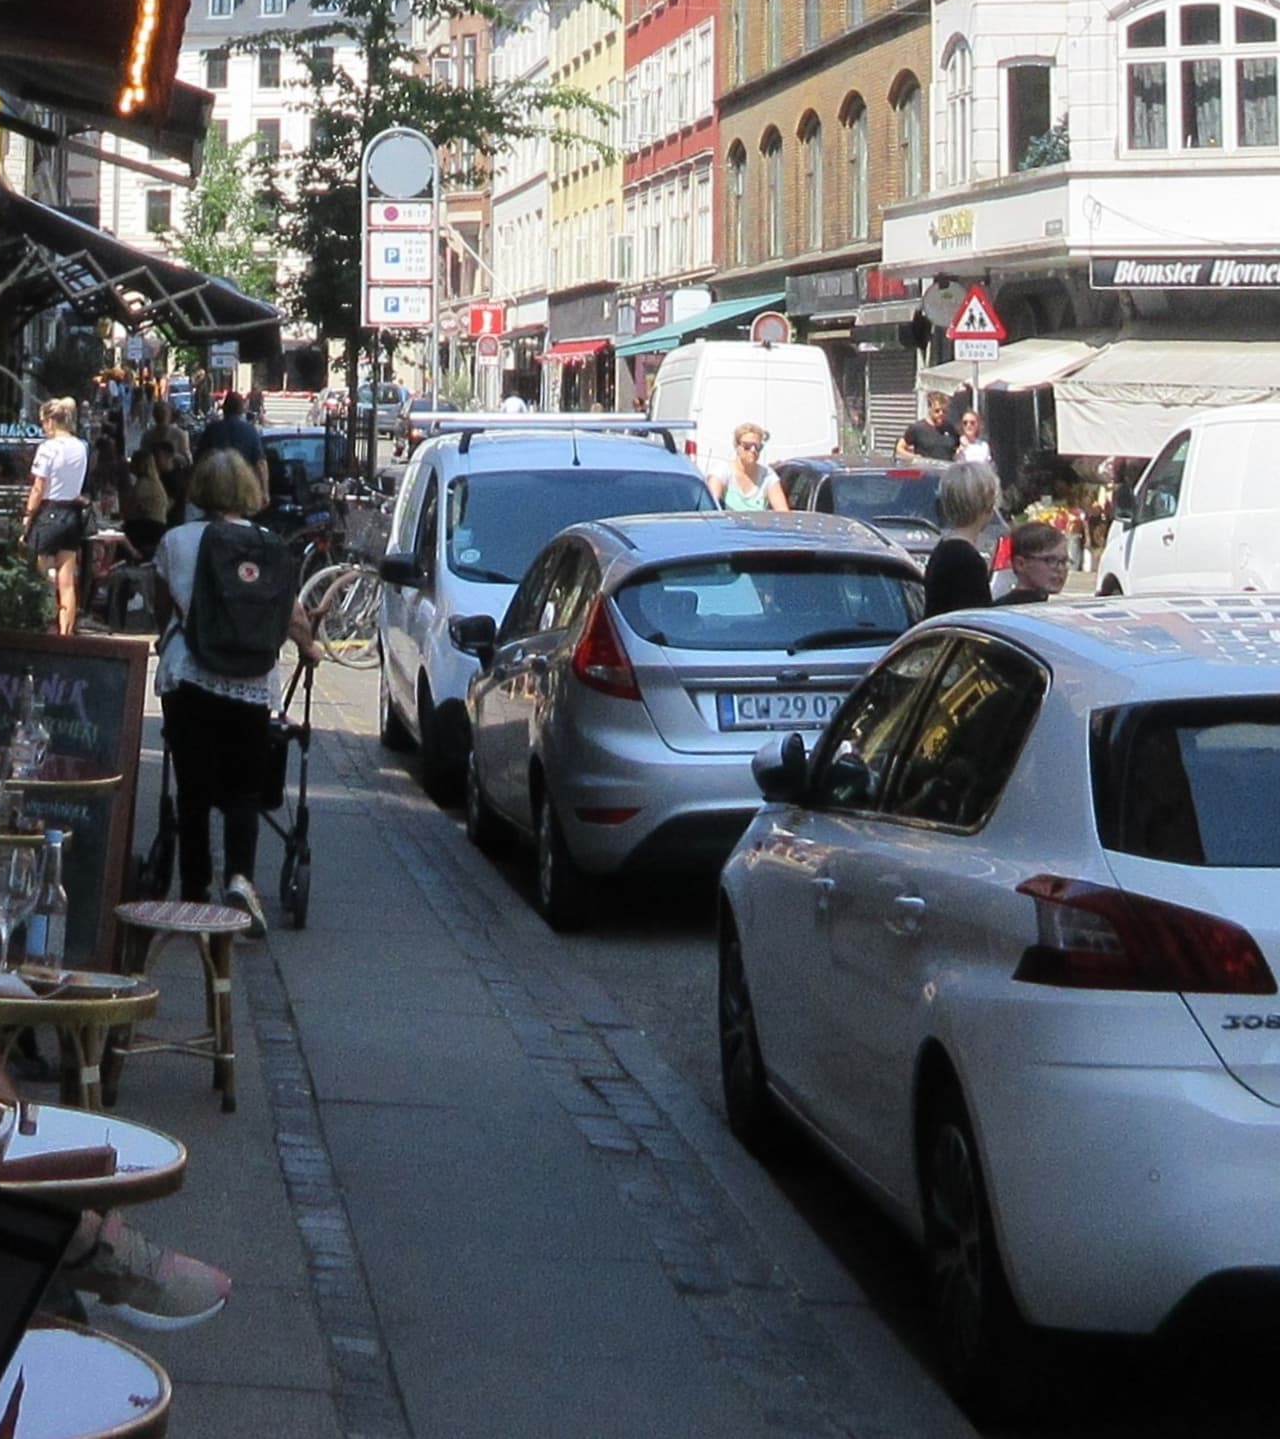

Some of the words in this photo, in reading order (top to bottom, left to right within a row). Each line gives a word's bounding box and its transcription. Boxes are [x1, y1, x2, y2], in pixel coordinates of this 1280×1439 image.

[1112, 260, 1202, 284] Blomster
[738, 697, 770, 719] CW
[777, 696, 807, 718] 29
